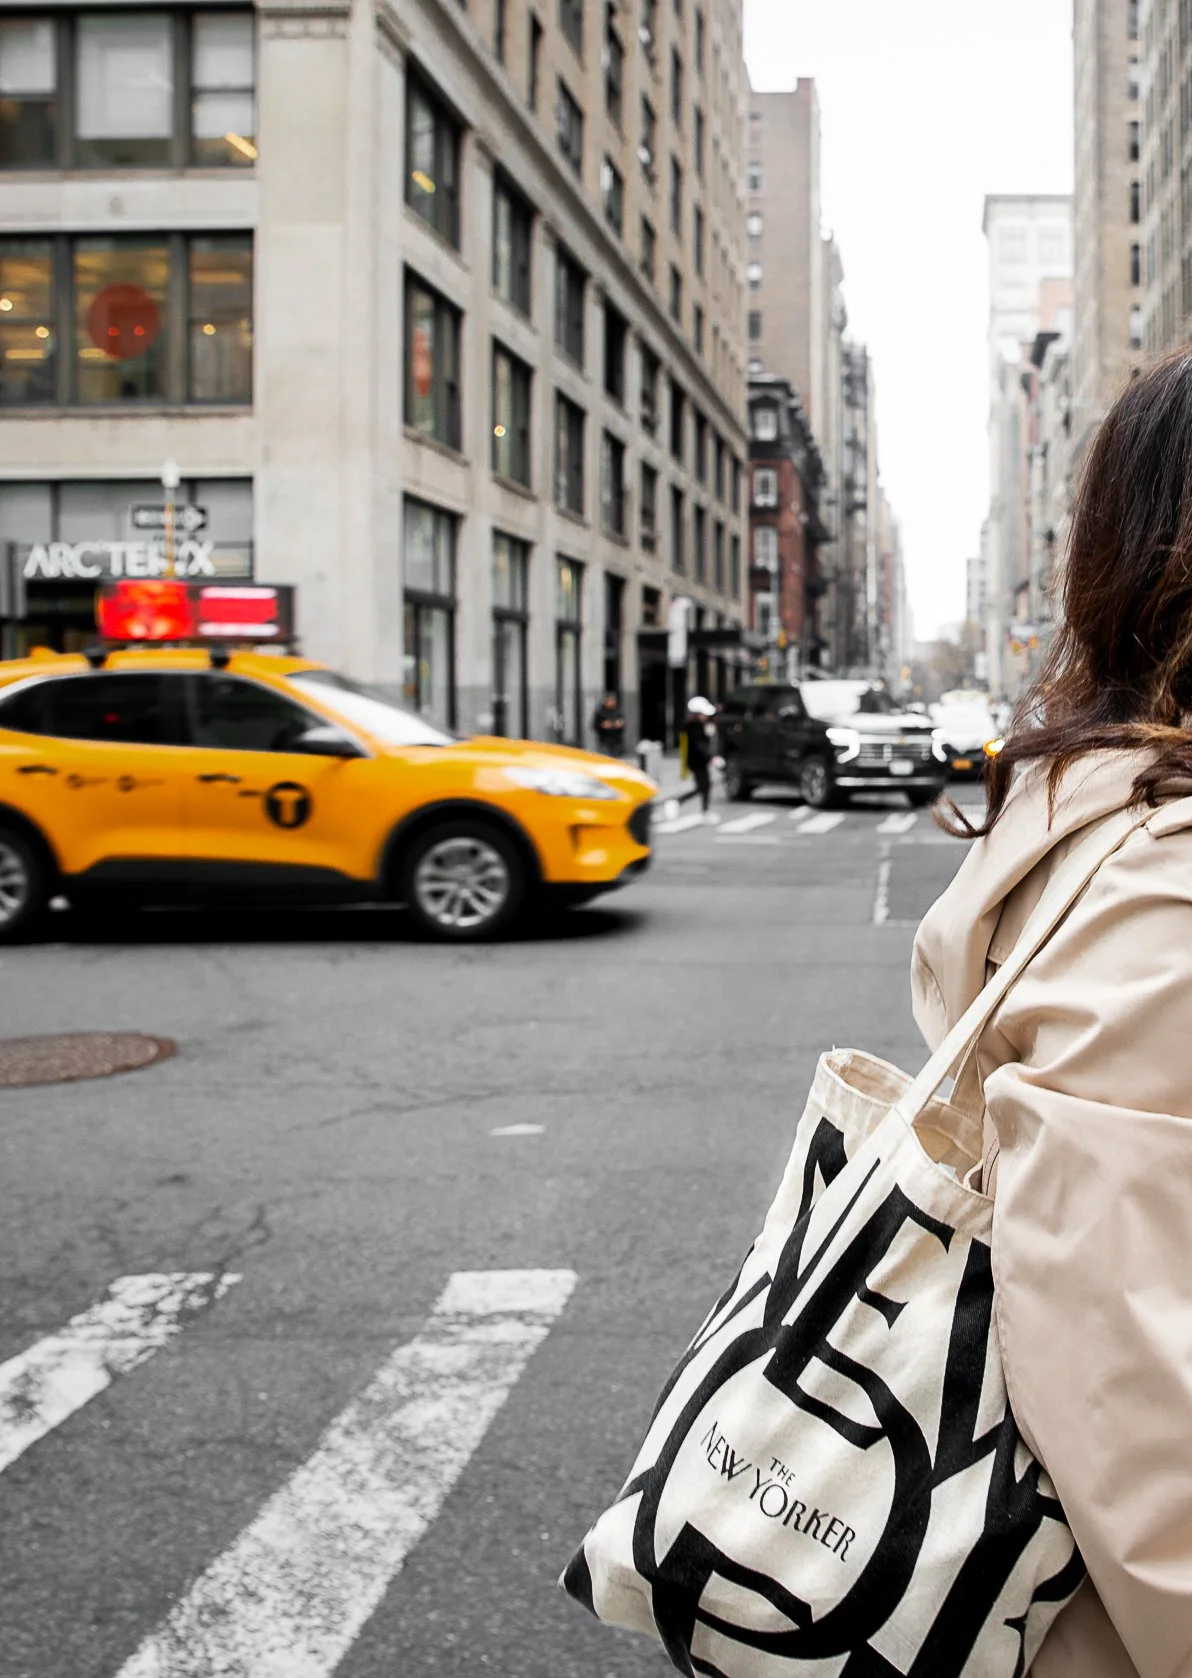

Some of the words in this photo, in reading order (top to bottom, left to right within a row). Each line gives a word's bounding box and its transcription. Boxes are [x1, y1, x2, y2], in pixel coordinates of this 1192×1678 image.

[270, 787, 306, 825] T
[771, 1456, 796, 1487] THE
[700, 1421, 752, 1482] NEW
[749, 1467, 856, 1563] YORKER
